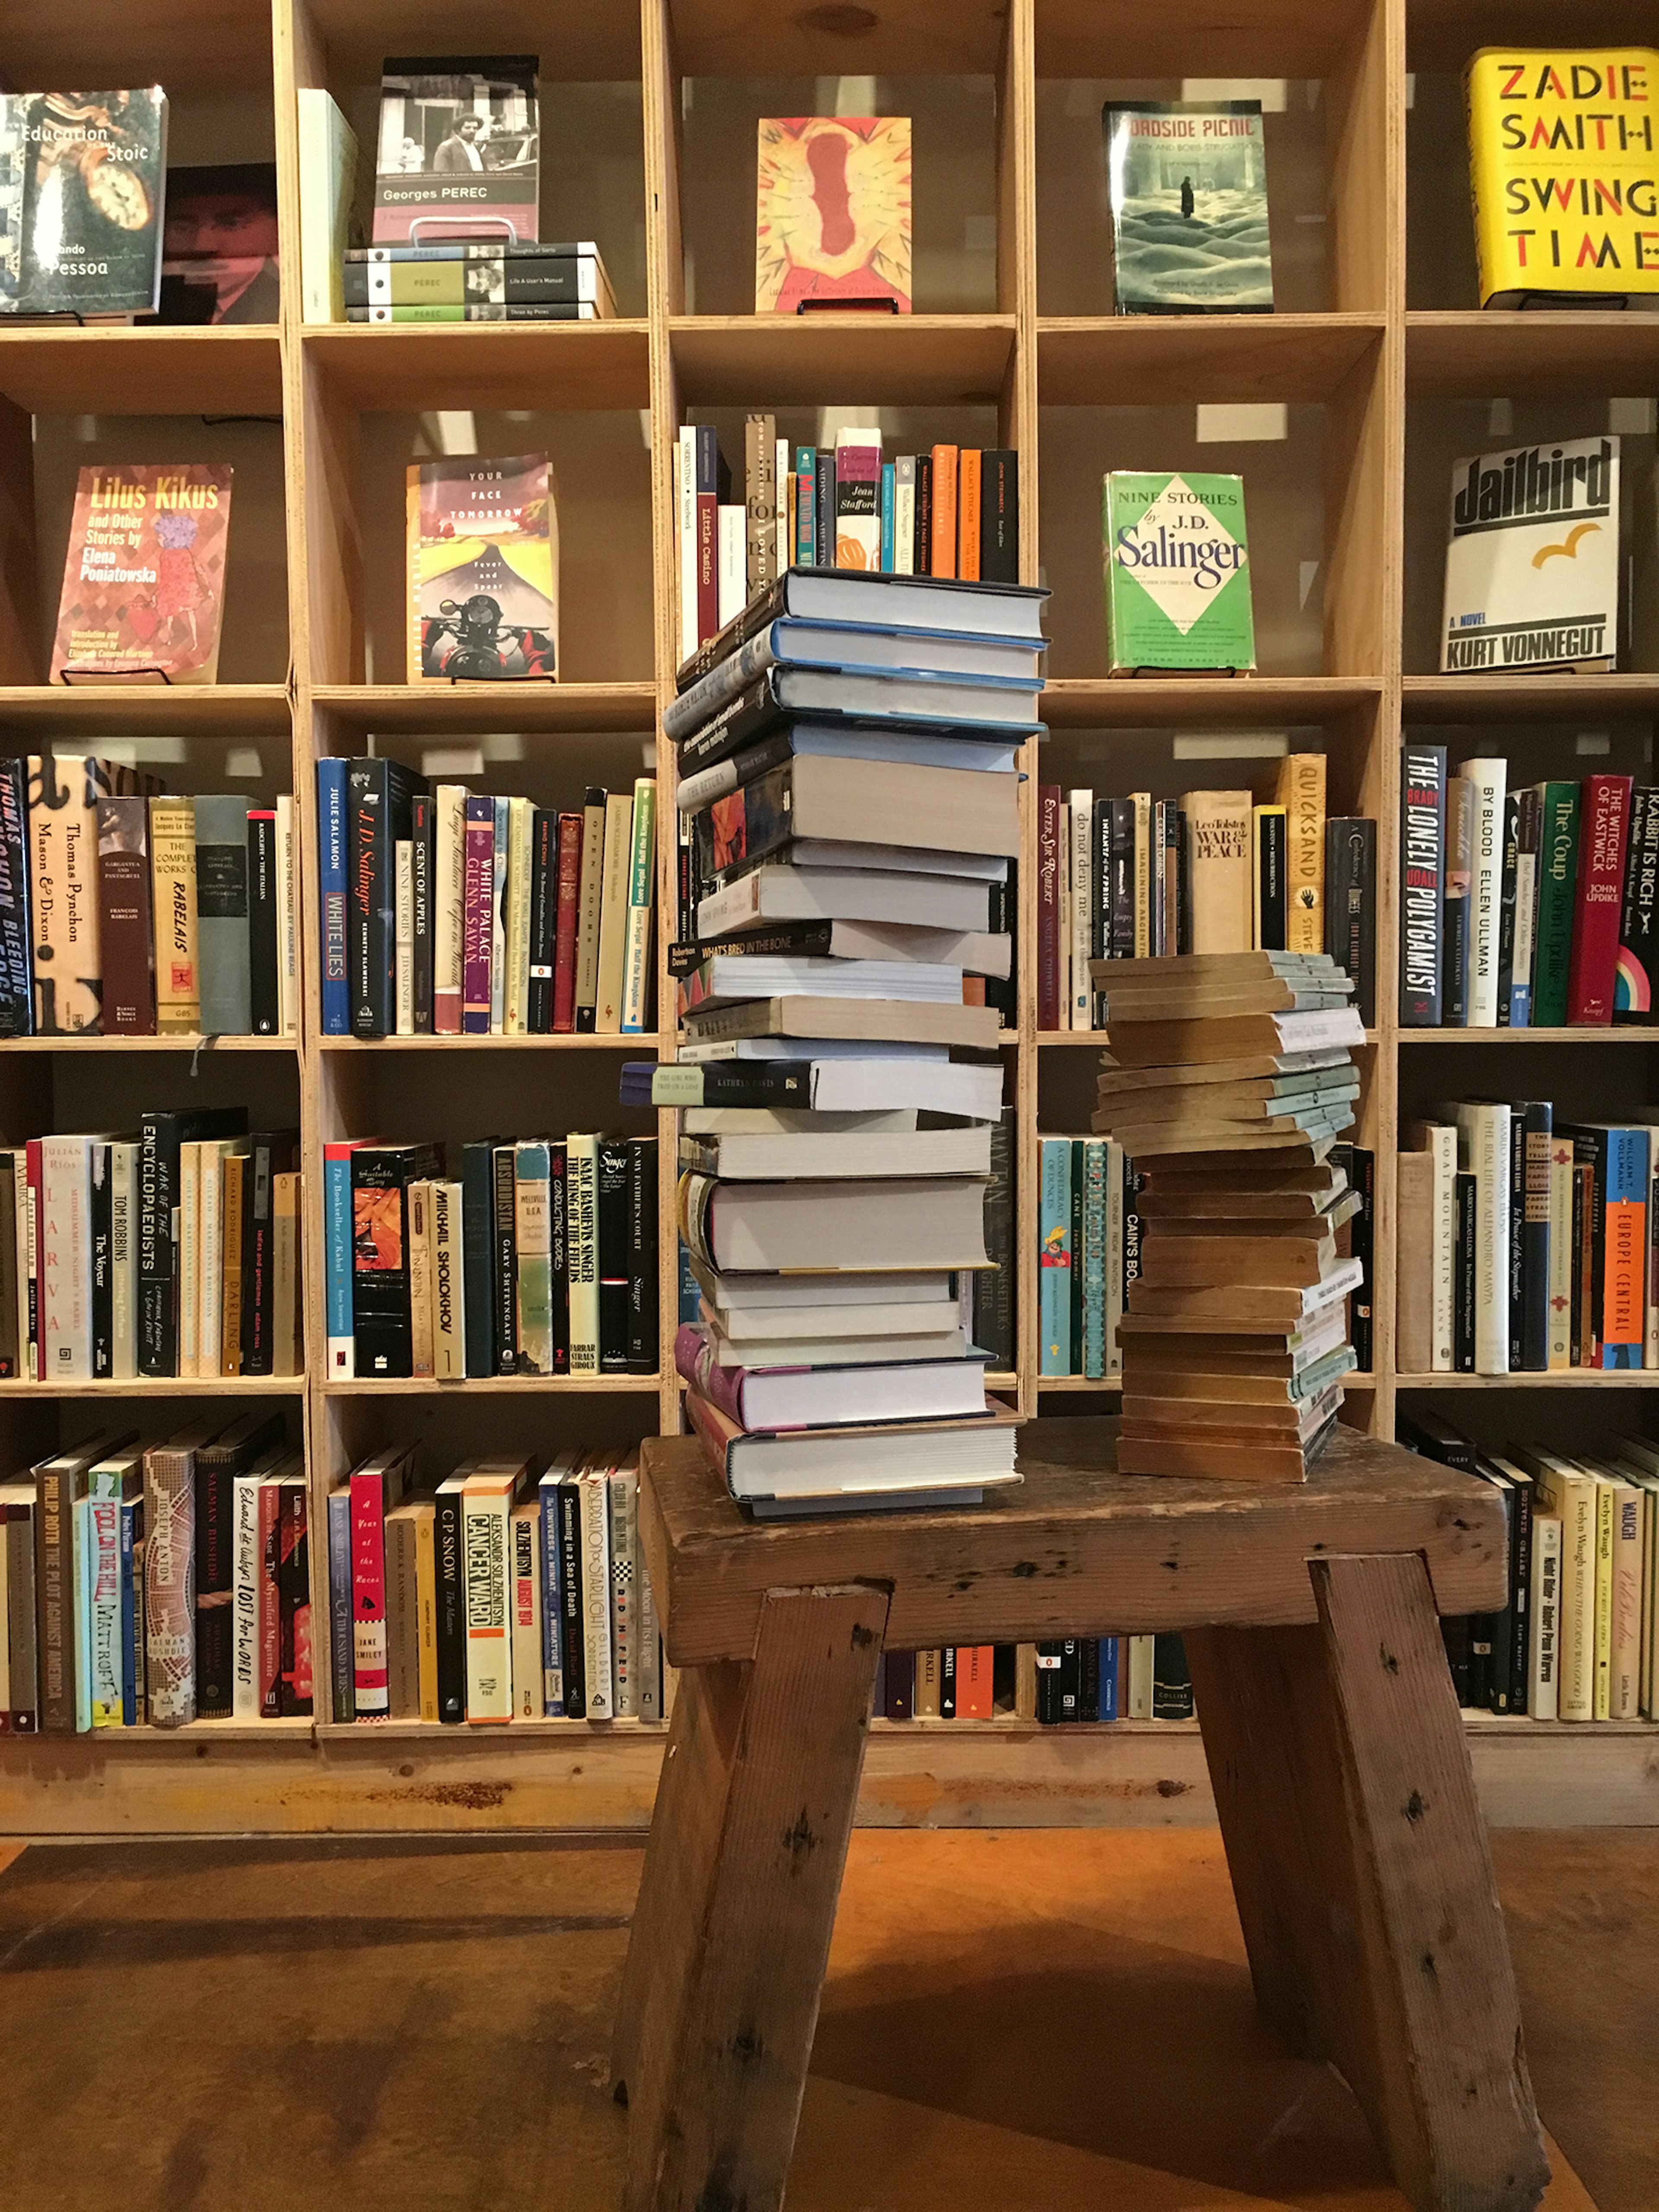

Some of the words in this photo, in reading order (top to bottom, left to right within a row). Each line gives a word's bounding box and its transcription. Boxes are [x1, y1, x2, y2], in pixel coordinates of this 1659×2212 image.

[1498, 65, 1648, 101] ZADIE
[22, 126, 108, 142] Education
[1501, 114, 1653, 151] SMITH
[106, 145, 149, 162] Stoic
[383, 190, 437, 201] Georges
[441, 188, 487, 198] PEREC
[1505, 178, 1657, 217] SWING
[1507, 230, 1659, 270] TIME
[50, 261, 108, 276] Pessoa
[90, 477, 146, 509] Lilus
[155, 477, 219, 509] Kikus
[470, 472, 503, 481] YOUR
[852, 486, 873, 496] Jean
[1455, 438, 1611, 524] Jailbird
[471, 490, 501, 500] FACE
[840, 499, 877, 510] Stafford
[1118, 493, 1161, 503] NINE
[1167, 493, 1238, 506] STORIES
[88, 514, 109, 528] and
[111, 513, 143, 529] Other
[450, 508, 523, 519] TOMORROW
[702, 508, 712, 544] Little
[1144, 509, 1160, 525] by
[1172, 516, 1209, 529] J.D.
[82, 547, 116, 564] Elena
[85, 530, 125, 545] Stories
[128, 530, 141, 549] by
[702, 546, 712, 586] Casino
[1117, 525, 1245, 589] Salinger
[79, 564, 156, 584] Poniatowska
[1449, 617, 1455, 628] A
[1460, 612, 1486, 627] NOVEL
[1447, 637, 1497, 669] KURT
[1502, 626, 1605, 662] VONNEGUT
[1408, 755, 1439, 793] THE
[329, 787, 339, 816] JULIE
[1407, 789, 1439, 805] BRADY
[1484, 786, 1494, 803] BY
[1598, 785, 1609, 803] OF
[1611, 788, 1623, 811] THE
[640, 804, 649, 837] Kingdom
[1077, 812, 1090, 830] do
[1195, 820, 1212, 830] Leo
[1214, 819, 1246, 830] Tolstoy
[1299, 767, 1317, 877] QUICKSAND
[1556, 799, 1573, 831] The
[1643, 793, 1659, 850] RABBIT
[38, 823, 52, 871] Mason
[169, 843, 186, 851] THE
[330, 818, 339, 870] SALAMON
[639, 837, 647, 850] the
[1077, 835, 1089, 855] not
[1196, 831, 1230, 844] WAR
[1233, 831, 1248, 843] &
[1406, 805, 1439, 872] LONELY
[1481, 809, 1494, 856] BLOOD
[1592, 806, 1608, 872] EASTWICK
[1605, 812, 1622, 871] WITCHES
[66, 823, 81, 879] Thomas
[416, 840, 426, 872] SCENT
[638, 852, 647, 867] Half
[1197, 845, 1246, 859] PEACE
[1549, 834, 1573, 881] Coup
[1643, 852, 1658, 865] IS
[39, 876, 54, 895] &
[156, 865, 187, 874] WORKS
[416, 875, 426, 890] OF
[467, 857, 479, 907] GLENN
[479, 859, 493, 902] WHITE
[637, 868, 645, 885] Segal
[1075, 859, 1091, 891] deny
[1406, 869, 1438, 888] UDALL
[636, 887, 645, 904] Lore
[1480, 869, 1492, 913] ELLEN
[1586, 893, 1618, 903] UPDIKE
[1590, 884, 1616, 894] JOHN
[1638, 868, 1656, 907] RICH
[40, 898, 54, 942] Dixon
[67, 884, 82, 943] Pynchon
[173, 880, 187, 953] RABELAIS
[327, 896, 343, 944] WHITE
[416, 893, 426, 936] APPLES
[587, 883, 595, 943] DOORS
[1078, 897, 1087, 917] me
[465, 916, 478, 965] SAVAN
[478, 909, 491, 964] PALACE
[1303, 917, 1313, 950] STEVE
[1405, 887, 1438, 996] POLYGAMIST
[1477, 918, 1491, 977] ULLMAN
[327, 947, 343, 977] LIES
[580, 1156, 592, 1187] ISAAC
[599, 1151, 628, 1173] Singer
[1443, 1136, 1451, 1178] GOAT
[114, 1195, 127, 1213] TOM
[333, 1185, 343, 1233] Bookseller
[497, 1157, 513, 1232] ABSURDISTAN
[436, 1189, 448, 1246] MIKHAIL
[580, 1191, 593, 1243] BASHEVIS
[95, 1233, 106, 1248] The
[114, 1216, 127, 1261] ROBBINS
[1125, 1214, 1138, 1257] CAIN'S
[1441, 1191, 1450, 1285] MOUNTAIN
[1616, 1214, 1632, 1265] EUROPE
[335, 1246, 344, 1273] Kabul
[502, 1238, 512, 1268] GARY
[581, 1244, 594, 1283] SINGER
[95, 1254, 108, 1289] Voyeur
[438, 1251, 452, 1334] SHOLOKHOV
[502, 1272, 512, 1342] SHTEYNGART
[1615, 1273, 1631, 1331] CENTRAL
[44, 1475, 59, 1513] PHILIP
[238, 1486, 254, 1531] Edward
[1602, 1493, 1611, 1526] Evelyn
[44, 1514, 59, 1545] ROTH
[159, 1498, 170, 1540] JOSEPH
[564, 1498, 574, 1544] Swimming
[1577, 1500, 1587, 1532] Evelyn
[1621, 1501, 1637, 1541] WAUGH
[469, 1515, 490, 1578] CANCER
[491, 1513, 503, 1563] ALEKSANDR
[1574, 1534, 1586, 1567] Waugh
[1601, 1527, 1610, 1560] Waugh
[159, 1544, 170, 1583] ANTON
[566, 1561, 575, 1578] Sea
[45, 1569, 60, 1599] PLOT
[238, 1584, 254, 1616] LOST
[492, 1564, 504, 1626] SOLZHENITSYN
[469, 1579, 492, 1626] WARD
[567, 1591, 577, 1617] Death
[45, 1601, 61, 1647] AGAINST
[238, 1616, 254, 1635] for
[237, 1637, 254, 1685] WORDS
[356, 1650, 382, 1659] SMILEY
[45, 1649, 61, 1700] AMERICA
